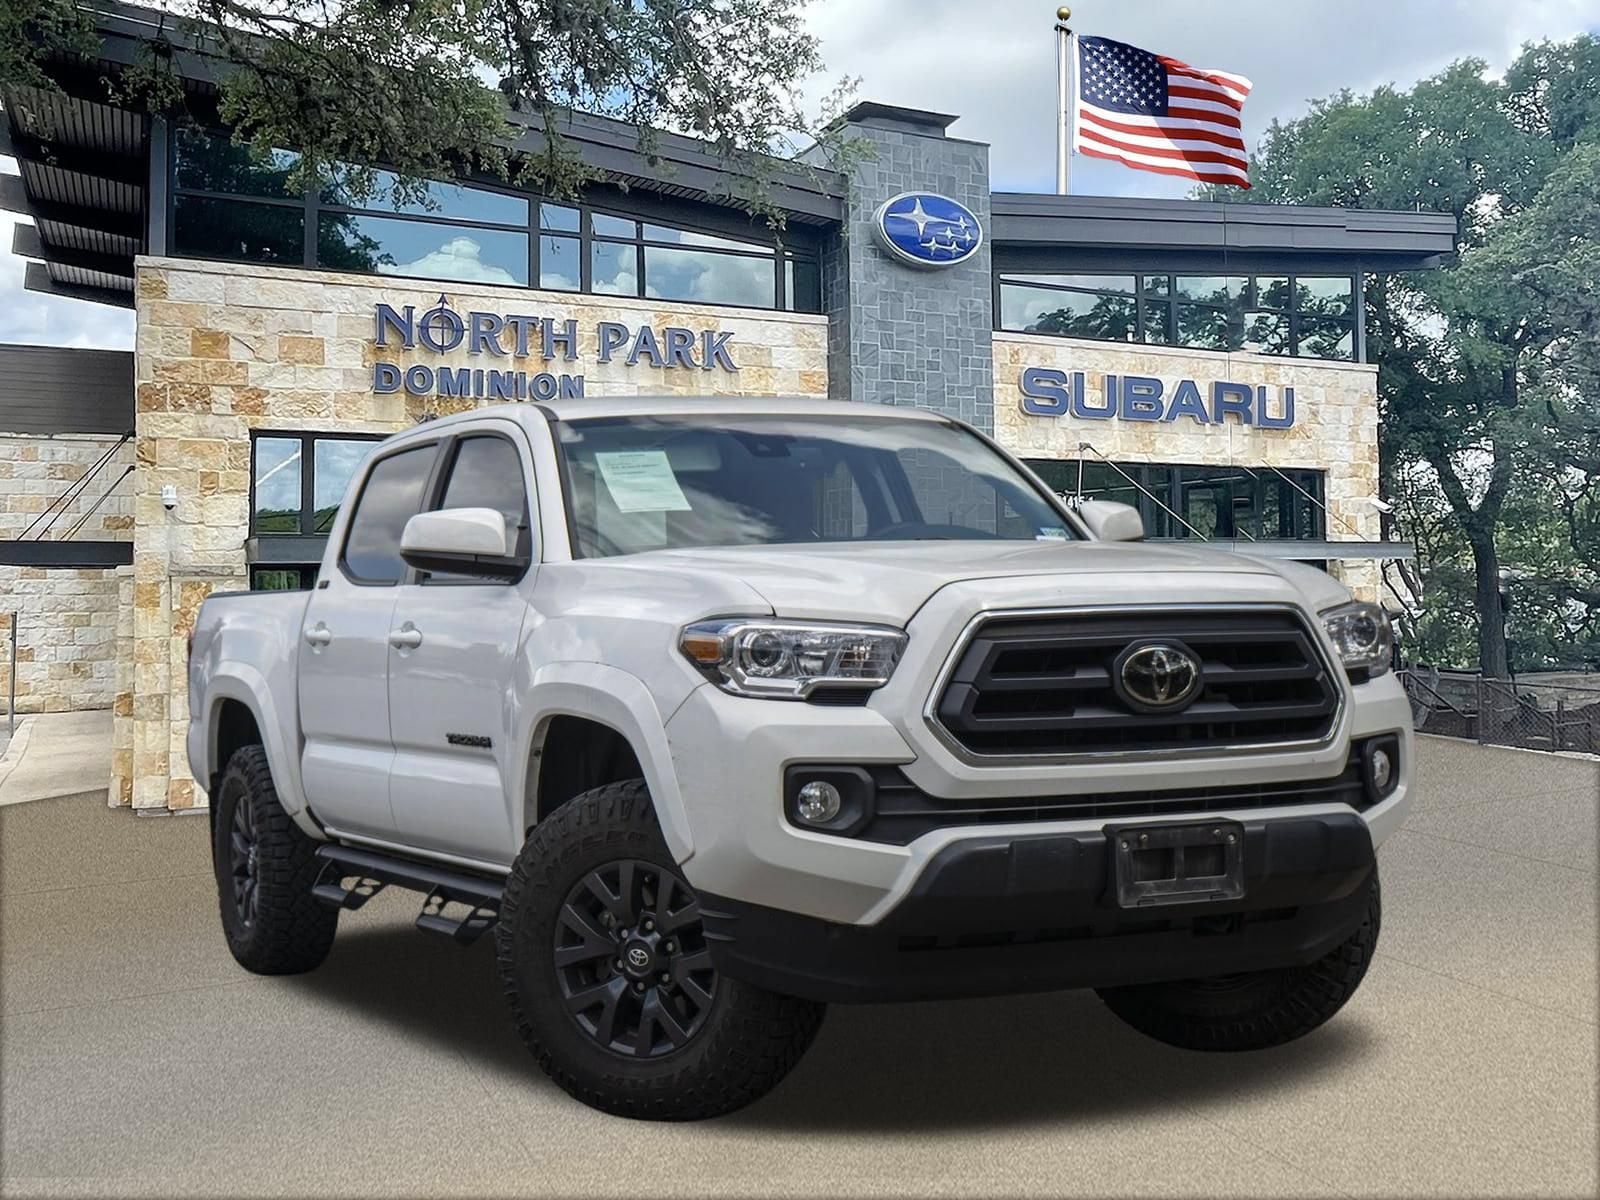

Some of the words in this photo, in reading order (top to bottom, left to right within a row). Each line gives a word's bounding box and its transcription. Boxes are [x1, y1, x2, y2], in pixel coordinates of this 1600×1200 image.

[374, 303, 579, 361] NORTH
[597, 321, 742, 373] PARK
[373, 362, 585, 400] DOMINION
[1019, 366, 1295, 430] SUBARU
